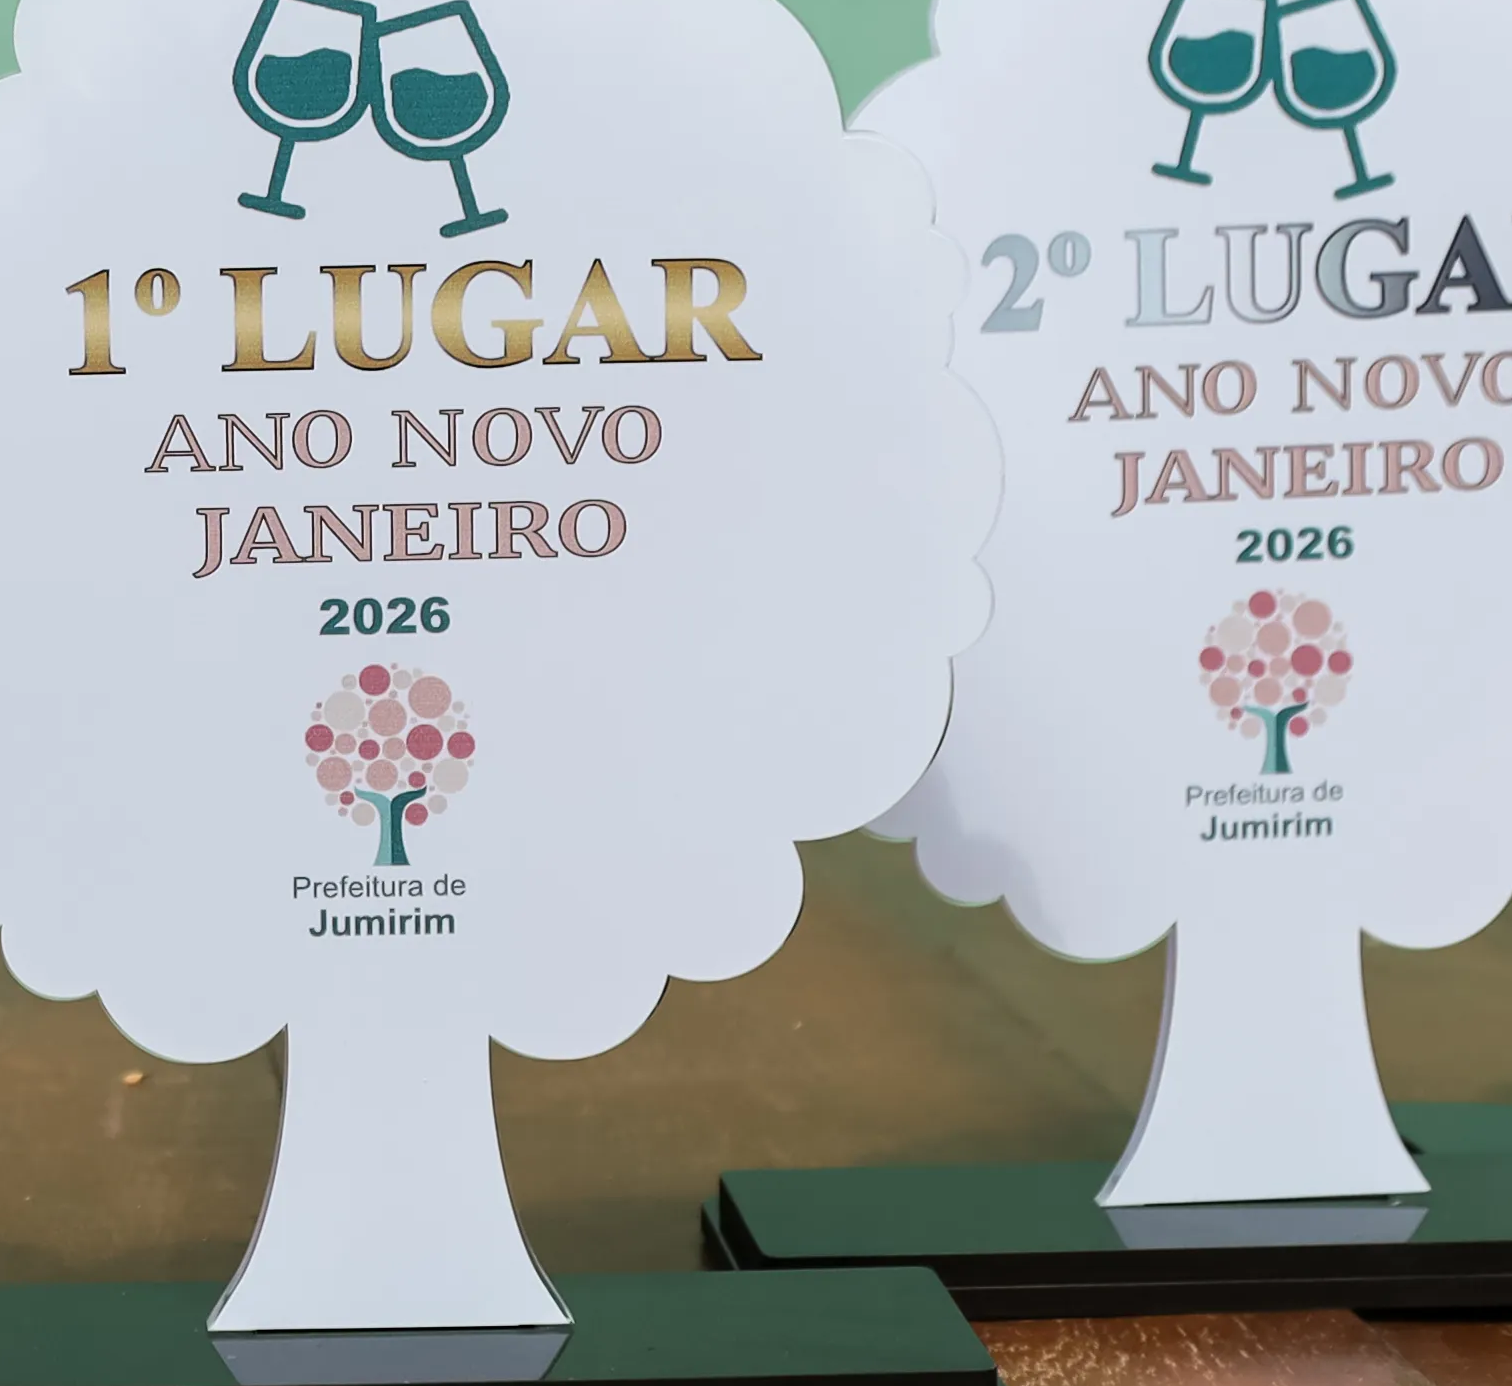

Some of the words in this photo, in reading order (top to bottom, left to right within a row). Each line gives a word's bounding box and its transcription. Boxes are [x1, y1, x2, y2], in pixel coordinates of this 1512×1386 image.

[220, 259, 763, 371] LUGAR
[1068, 360, 1258, 423] ANO
[145, 409, 352, 472] ANO
[391, 405, 662, 468] NOVO
[1111, 437, 1505, 517] JANEIRO
[193, 499, 627, 578] JANEIRO
[1236, 525, 1355, 563] 2026
[319, 596, 451, 635] 2026
[1186, 784, 1304, 807] Prefeitura
[1313, 780, 1343, 801] de
[1201, 812, 1332, 841] Jumirim
[293, 875, 423, 898] Prefeitura
[434, 874, 466, 896] de
[309, 908, 455, 936] Jumirim
